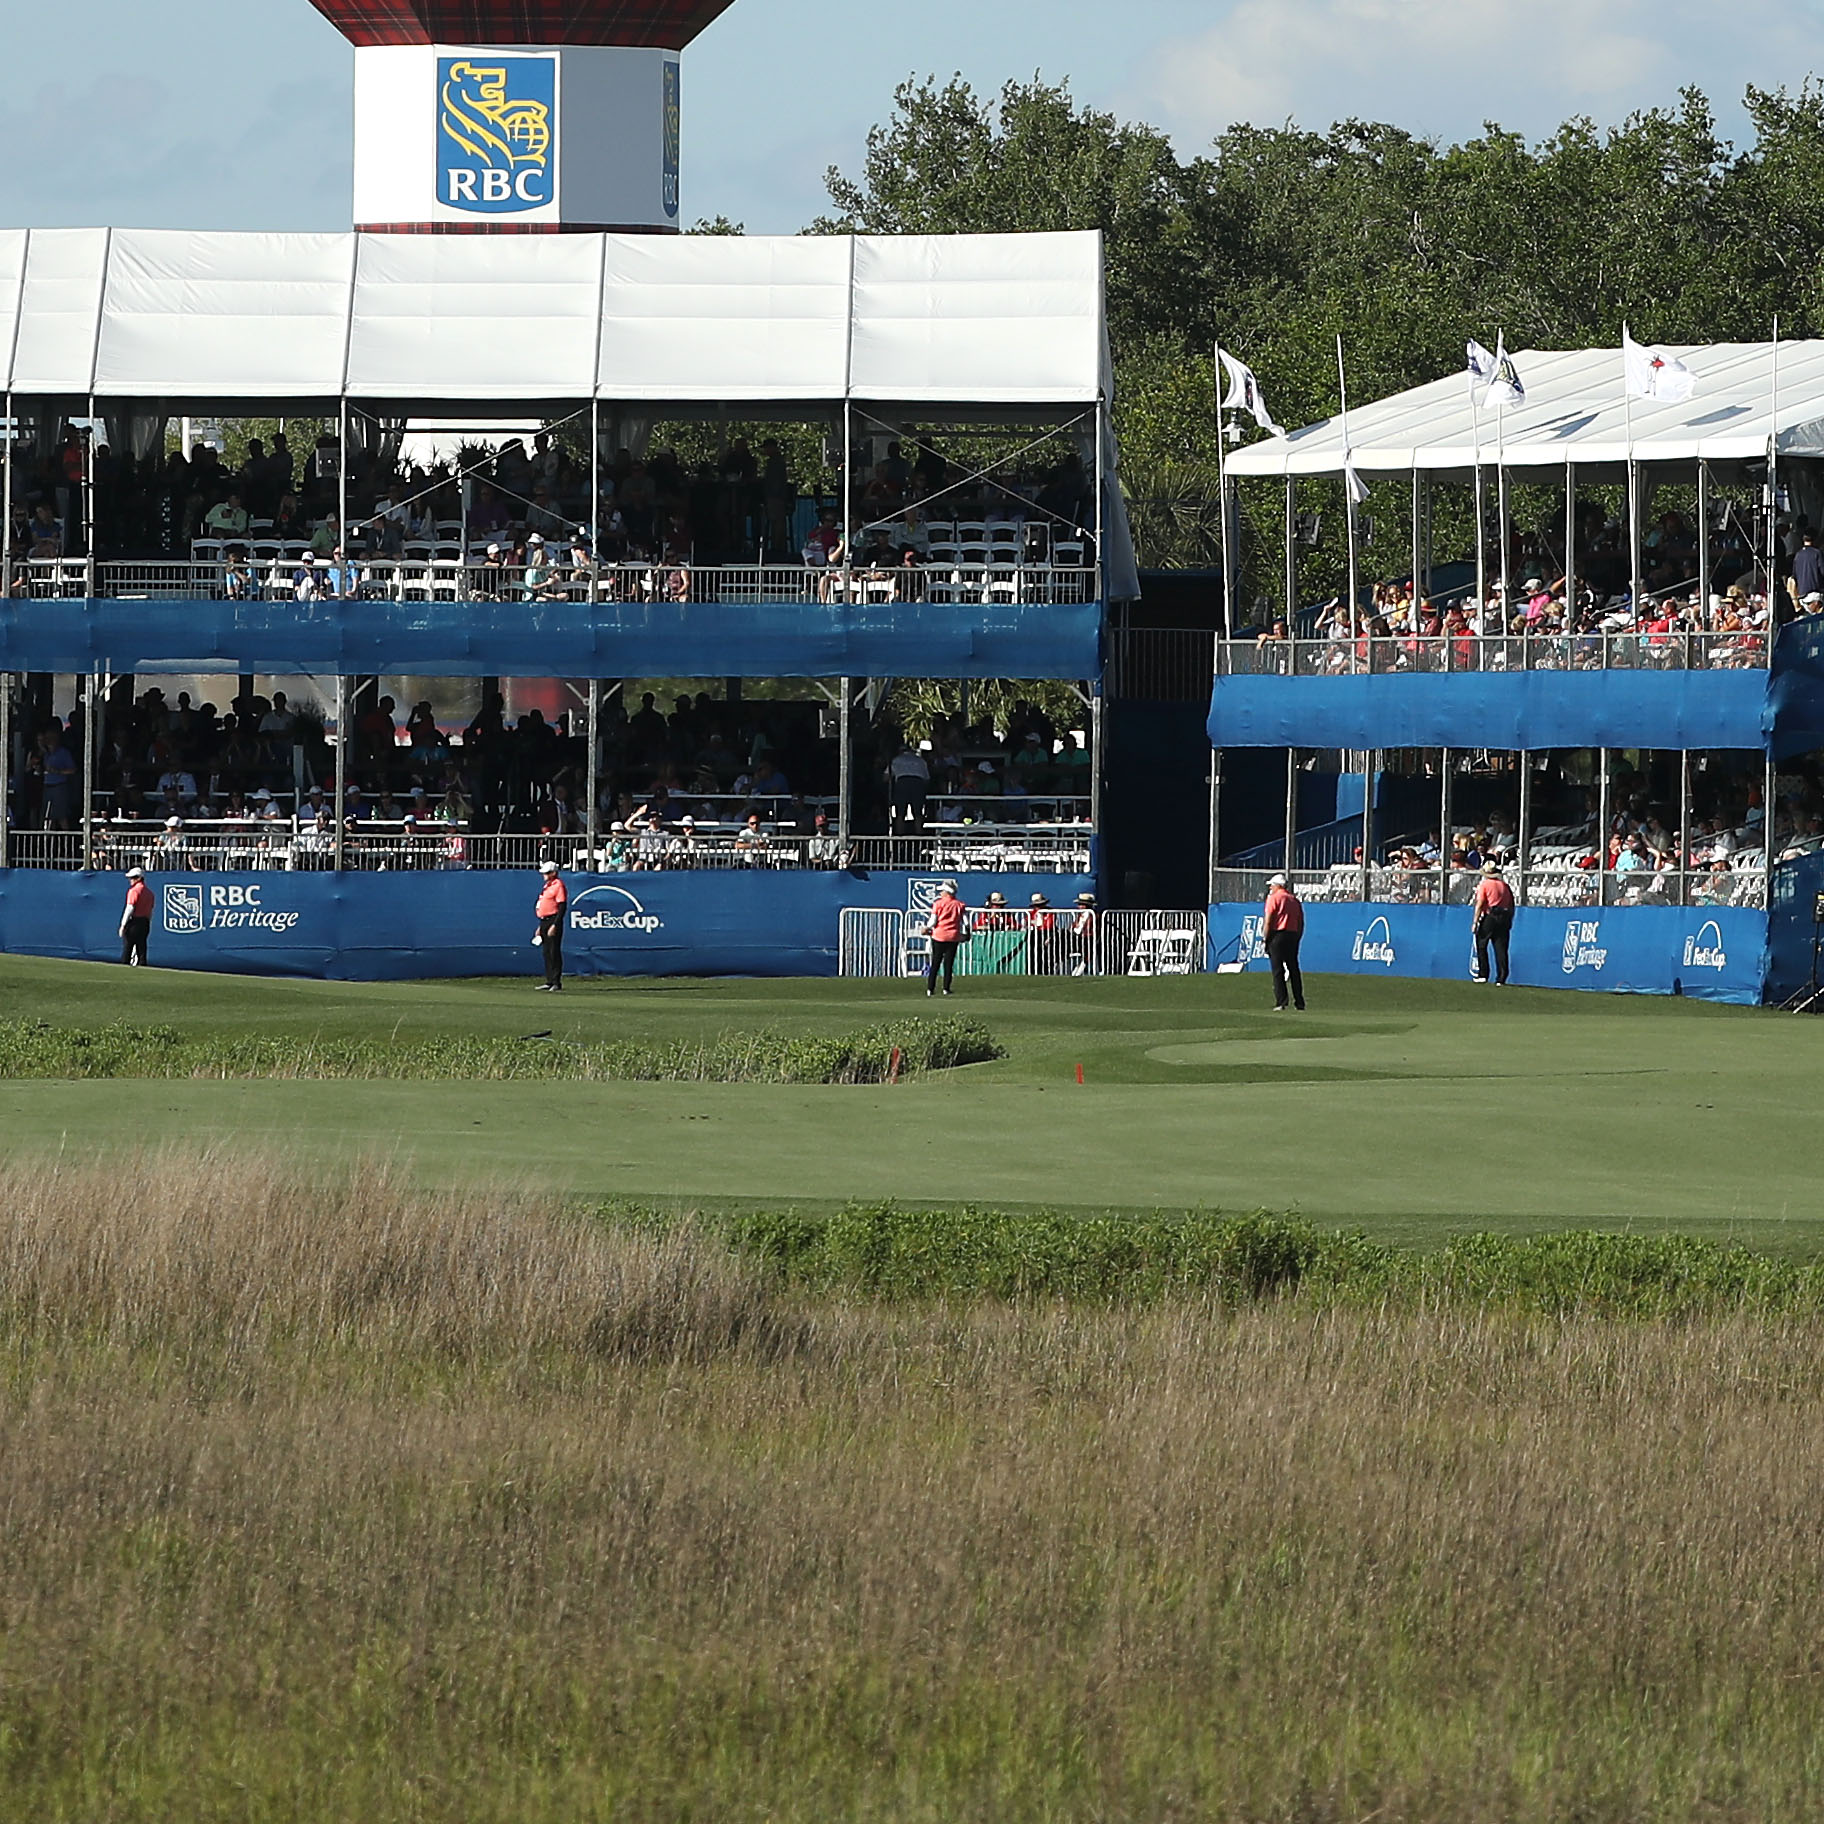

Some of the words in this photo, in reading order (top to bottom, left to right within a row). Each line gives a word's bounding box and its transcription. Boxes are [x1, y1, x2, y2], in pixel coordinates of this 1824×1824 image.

[447, 168, 544, 201] RBC
[210, 885, 261, 906] RBC
[168, 917, 198, 929] RBC
[209, 908, 300, 933] Heritage
[570, 910, 660, 934] FedExCup
[1580, 921, 1600, 943] RBC
